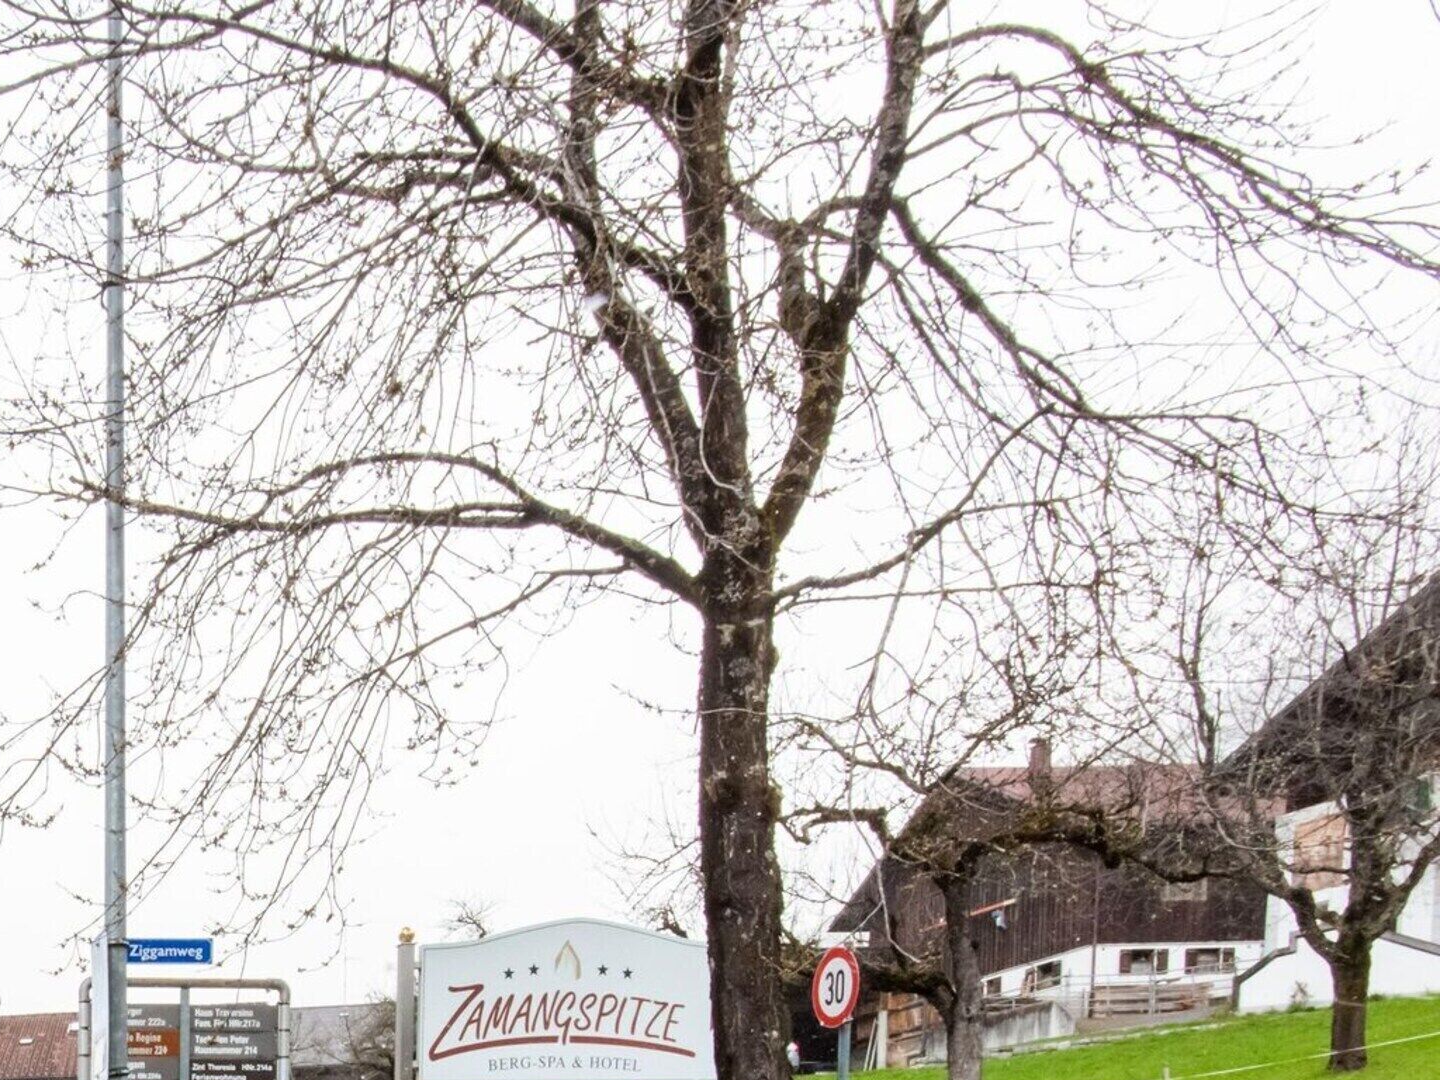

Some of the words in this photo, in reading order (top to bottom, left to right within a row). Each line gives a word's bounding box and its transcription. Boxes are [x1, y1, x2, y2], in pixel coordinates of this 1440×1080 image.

[129, 944, 204, 961] Ziggamweg
[825, 969, 845, 1006] 30
[194, 1007, 213, 1017] Haus
[429, 984, 690, 1061] ZAMANGSPITZE
[488, 1055, 566, 1073] BERG-SPA
[572, 1056, 583, 1069] &
[590, 1056, 642, 1072] HOTEL
